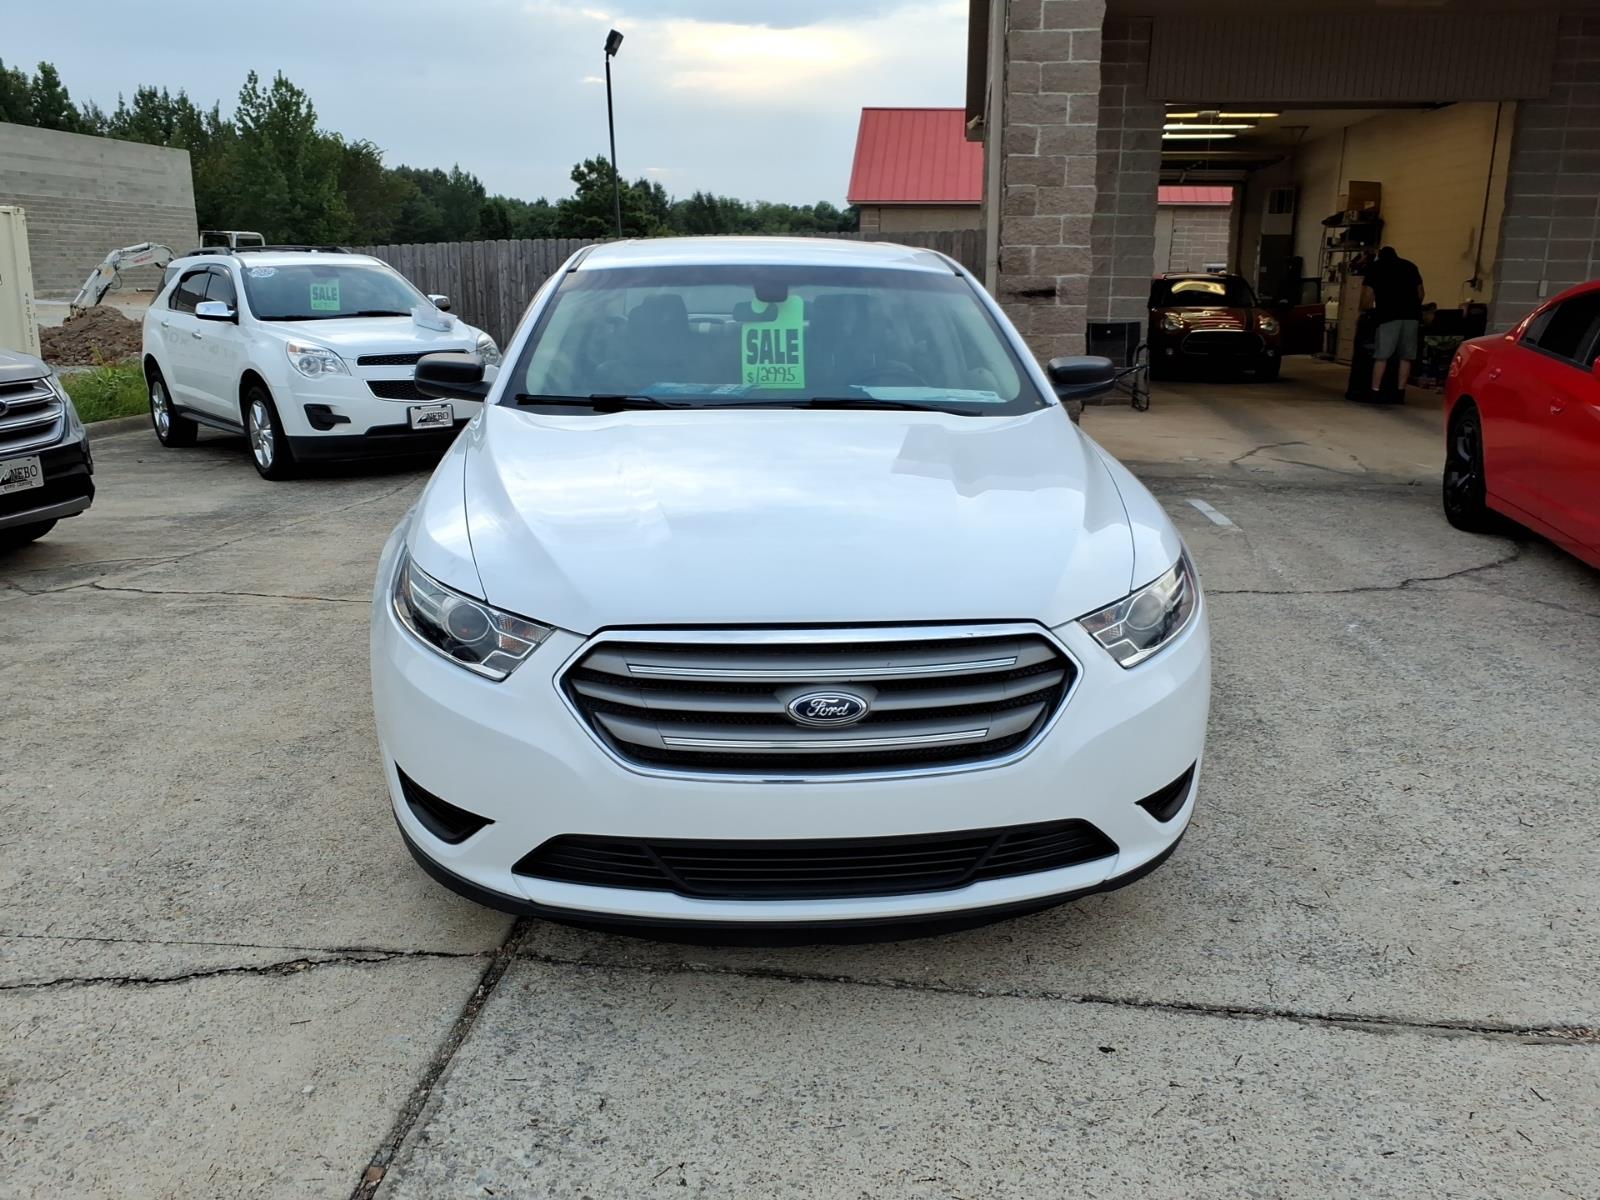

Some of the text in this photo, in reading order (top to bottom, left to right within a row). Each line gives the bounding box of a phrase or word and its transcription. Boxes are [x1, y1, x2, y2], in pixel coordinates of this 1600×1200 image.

[312, 286, 338, 301] SALE
[746, 328, 800, 365] SALE
[746, 366, 796, 383] $12995
[10, 464, 37, 481] NEBO
[806, 698, 850, 717] Ford
